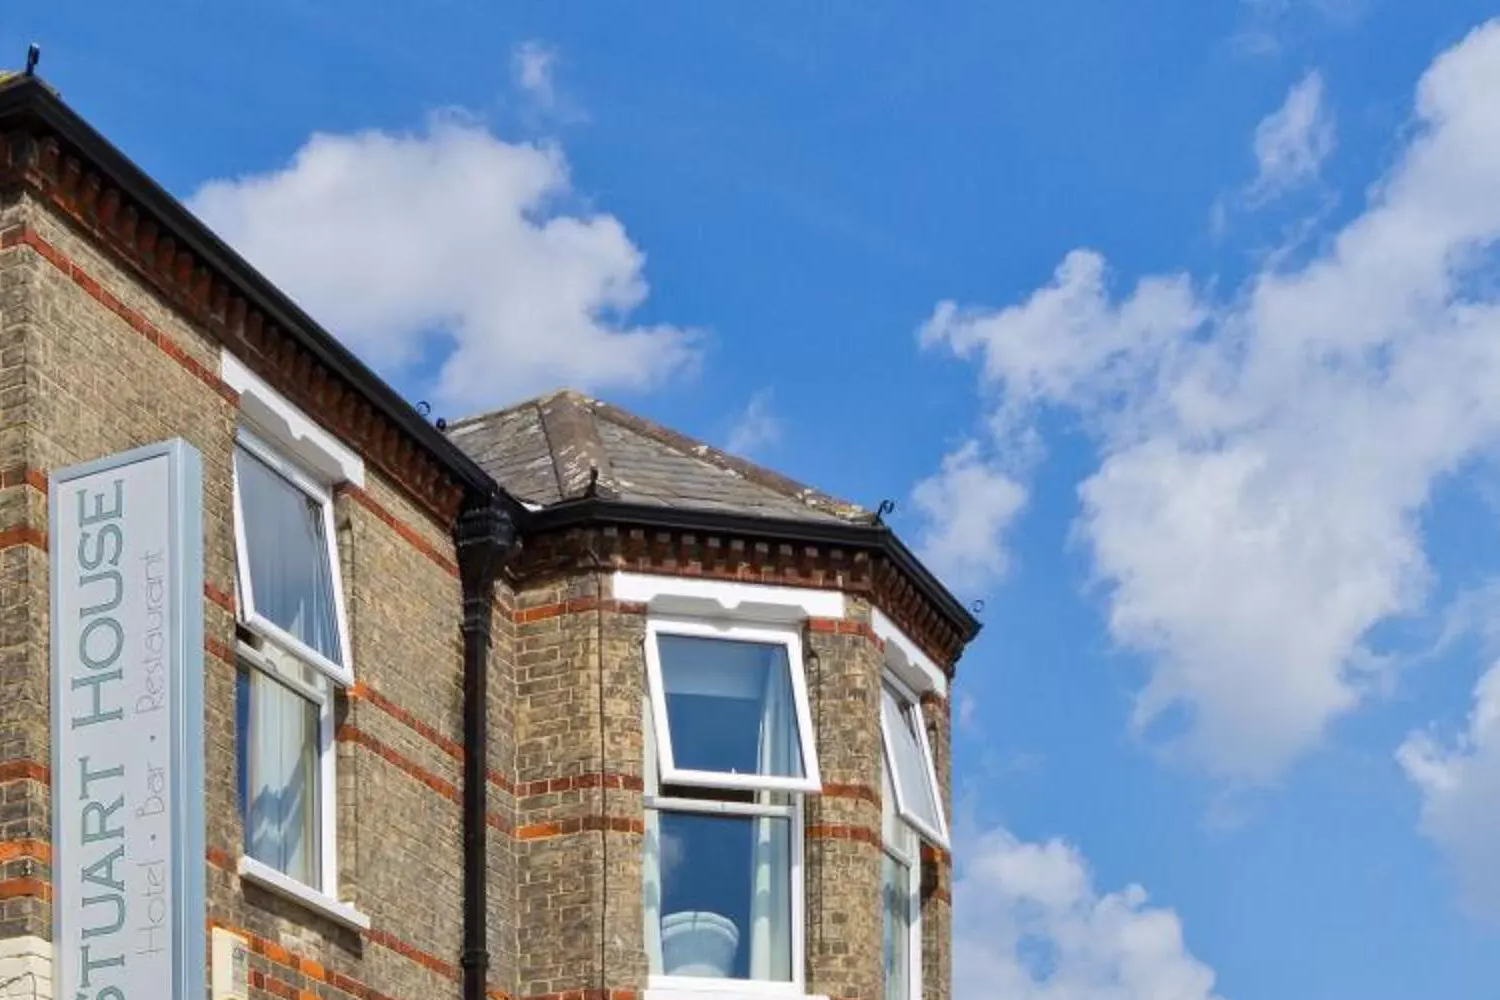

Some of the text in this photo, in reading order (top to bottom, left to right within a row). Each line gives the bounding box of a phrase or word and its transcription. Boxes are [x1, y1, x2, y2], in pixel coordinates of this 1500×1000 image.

[71, 479, 125, 731] HOUSE
[133, 549, 166, 957] Hotel Bar Restaurant
